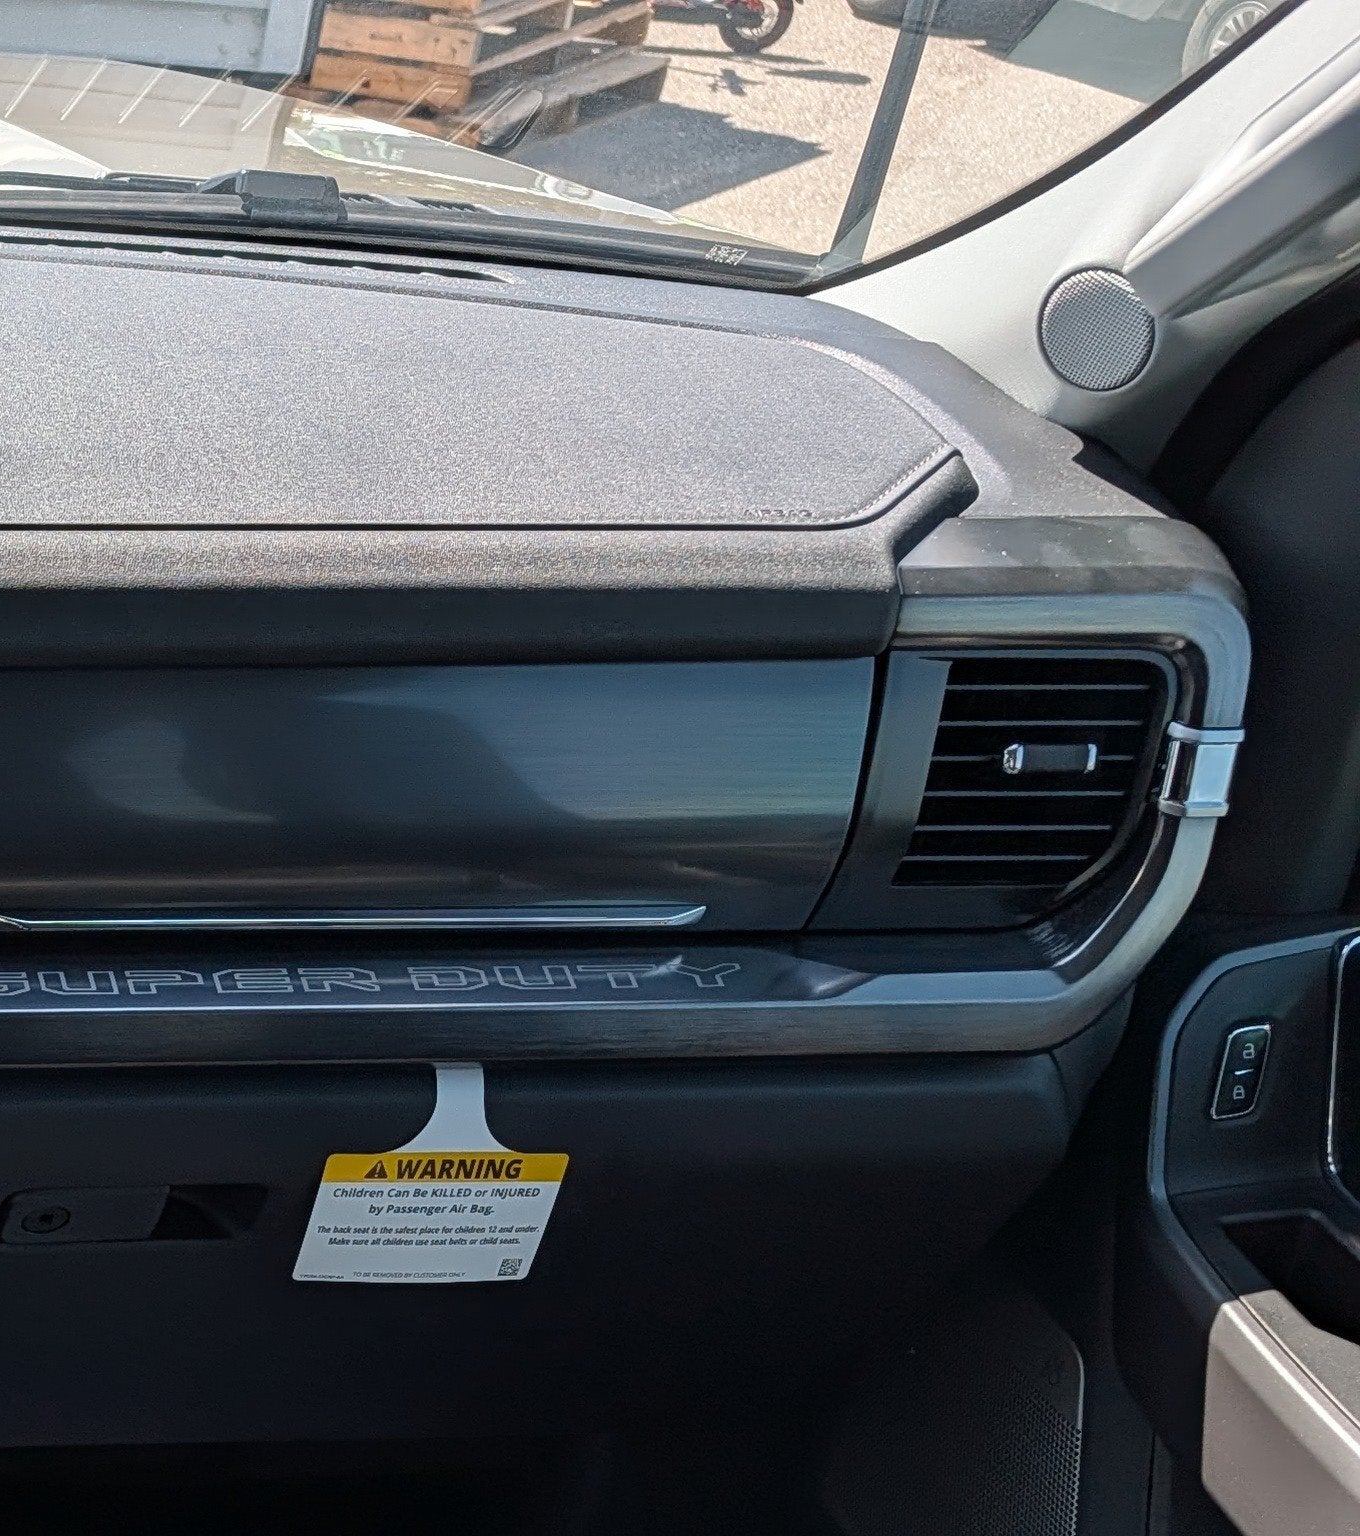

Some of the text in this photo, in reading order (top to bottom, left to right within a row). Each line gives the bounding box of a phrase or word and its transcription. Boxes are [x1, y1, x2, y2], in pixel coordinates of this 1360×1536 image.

[407, 963, 742, 993] DUTY
[396, 1159, 523, 1179] WARNING
[333, 1188, 541, 1200] Children Can Be KILLED or INJURED
[368, 1204, 495, 1216] by Passenger Air Bag.
[317, 1225, 331, 1234] The
[332, 1225, 351, 1234] back
[371, 1226, 378, 1234] is
[380, 1226, 393, 1234] the
[394, 1226, 418, 1234] safest
[419, 1226, 440, 1235] place
[441, 1225, 453, 1234] for
[454, 1225, 486, 1234] children
[514, 1225, 540, 1233] under.
[328, 1238, 351, 1246] Make
[370, 1238, 381, 1246] all
[382, 1238, 414, 1246] children
[448, 1238, 467, 1246] belts
[479, 1238, 499, 1246] child
